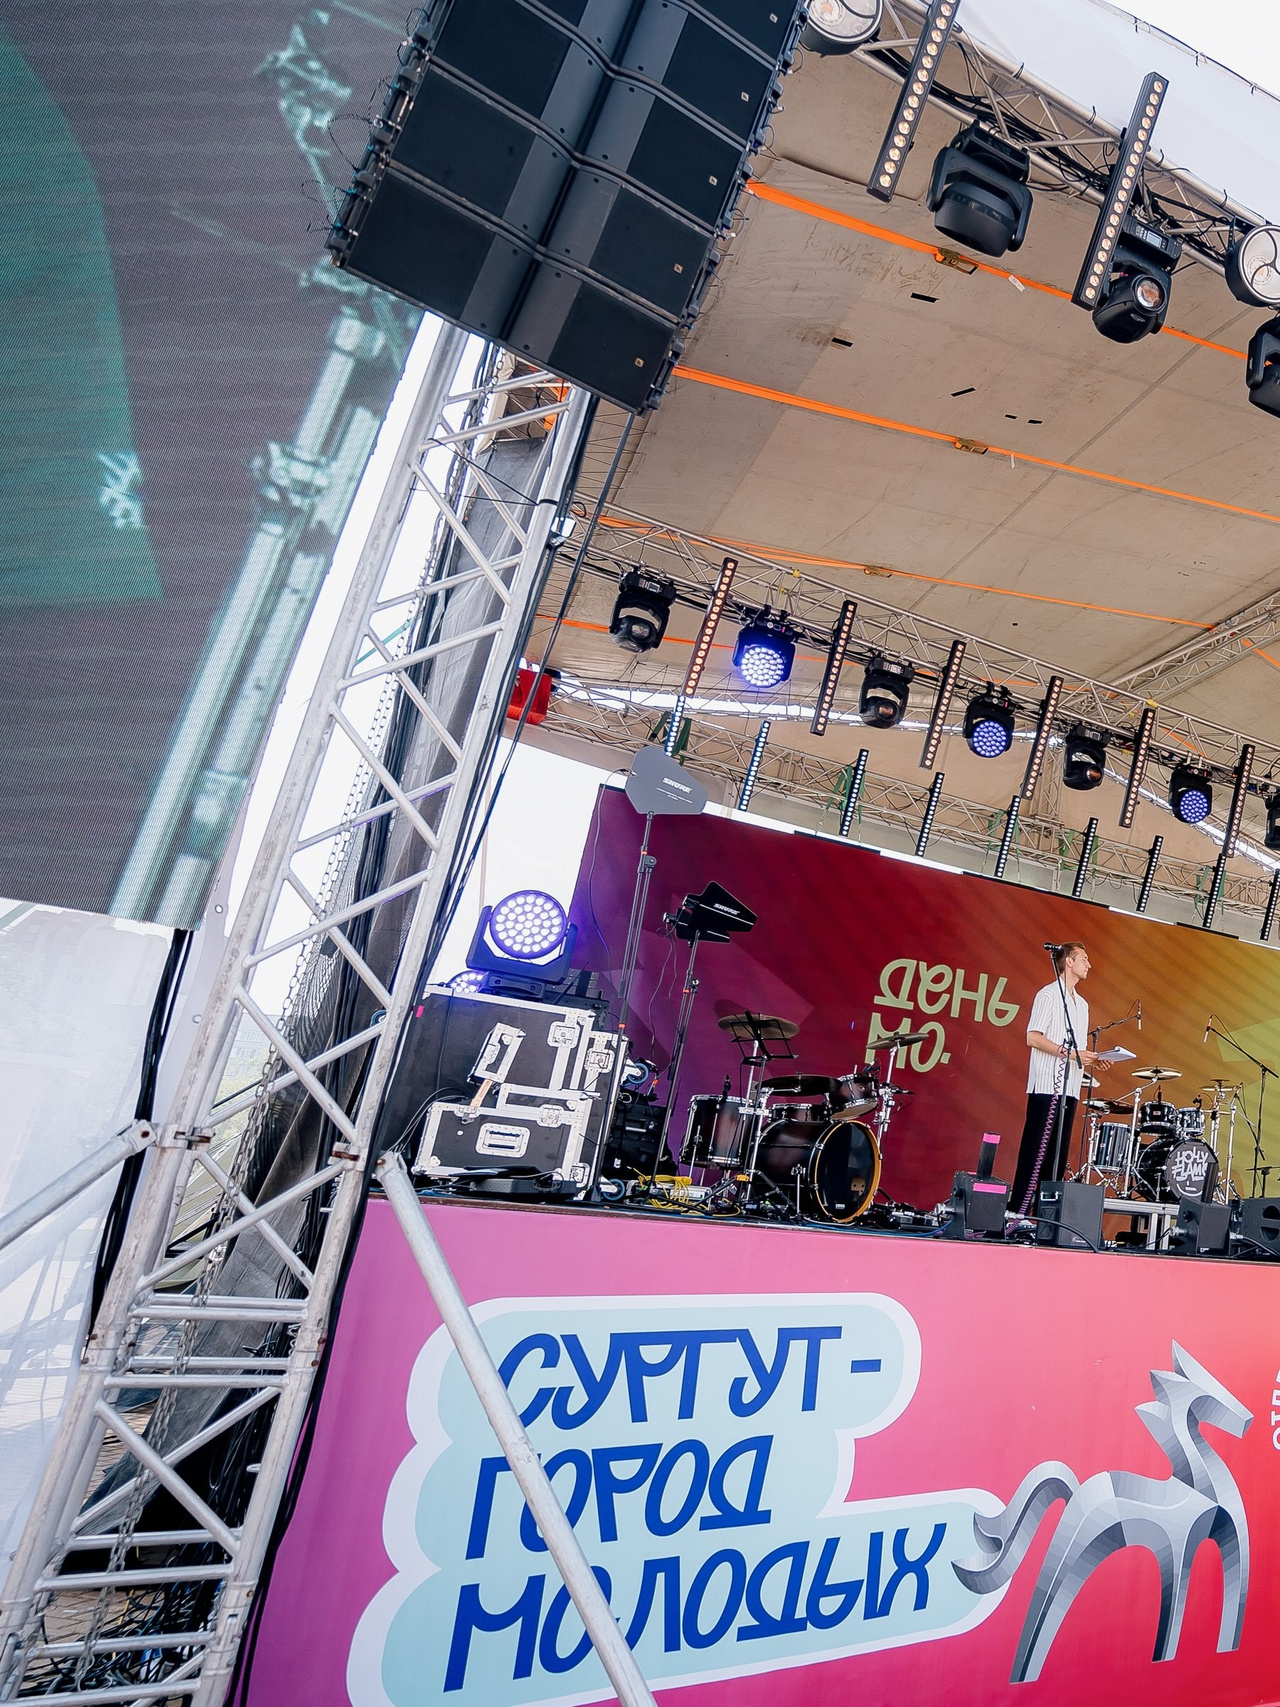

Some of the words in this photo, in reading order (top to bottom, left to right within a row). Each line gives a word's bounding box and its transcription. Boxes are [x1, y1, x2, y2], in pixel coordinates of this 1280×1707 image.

[662, 777, 693, 794] SHURE
[465, 1435, 774, 1560] ГОРОД
[442, 1522, 947, 1693] МОЛОДЫХ
